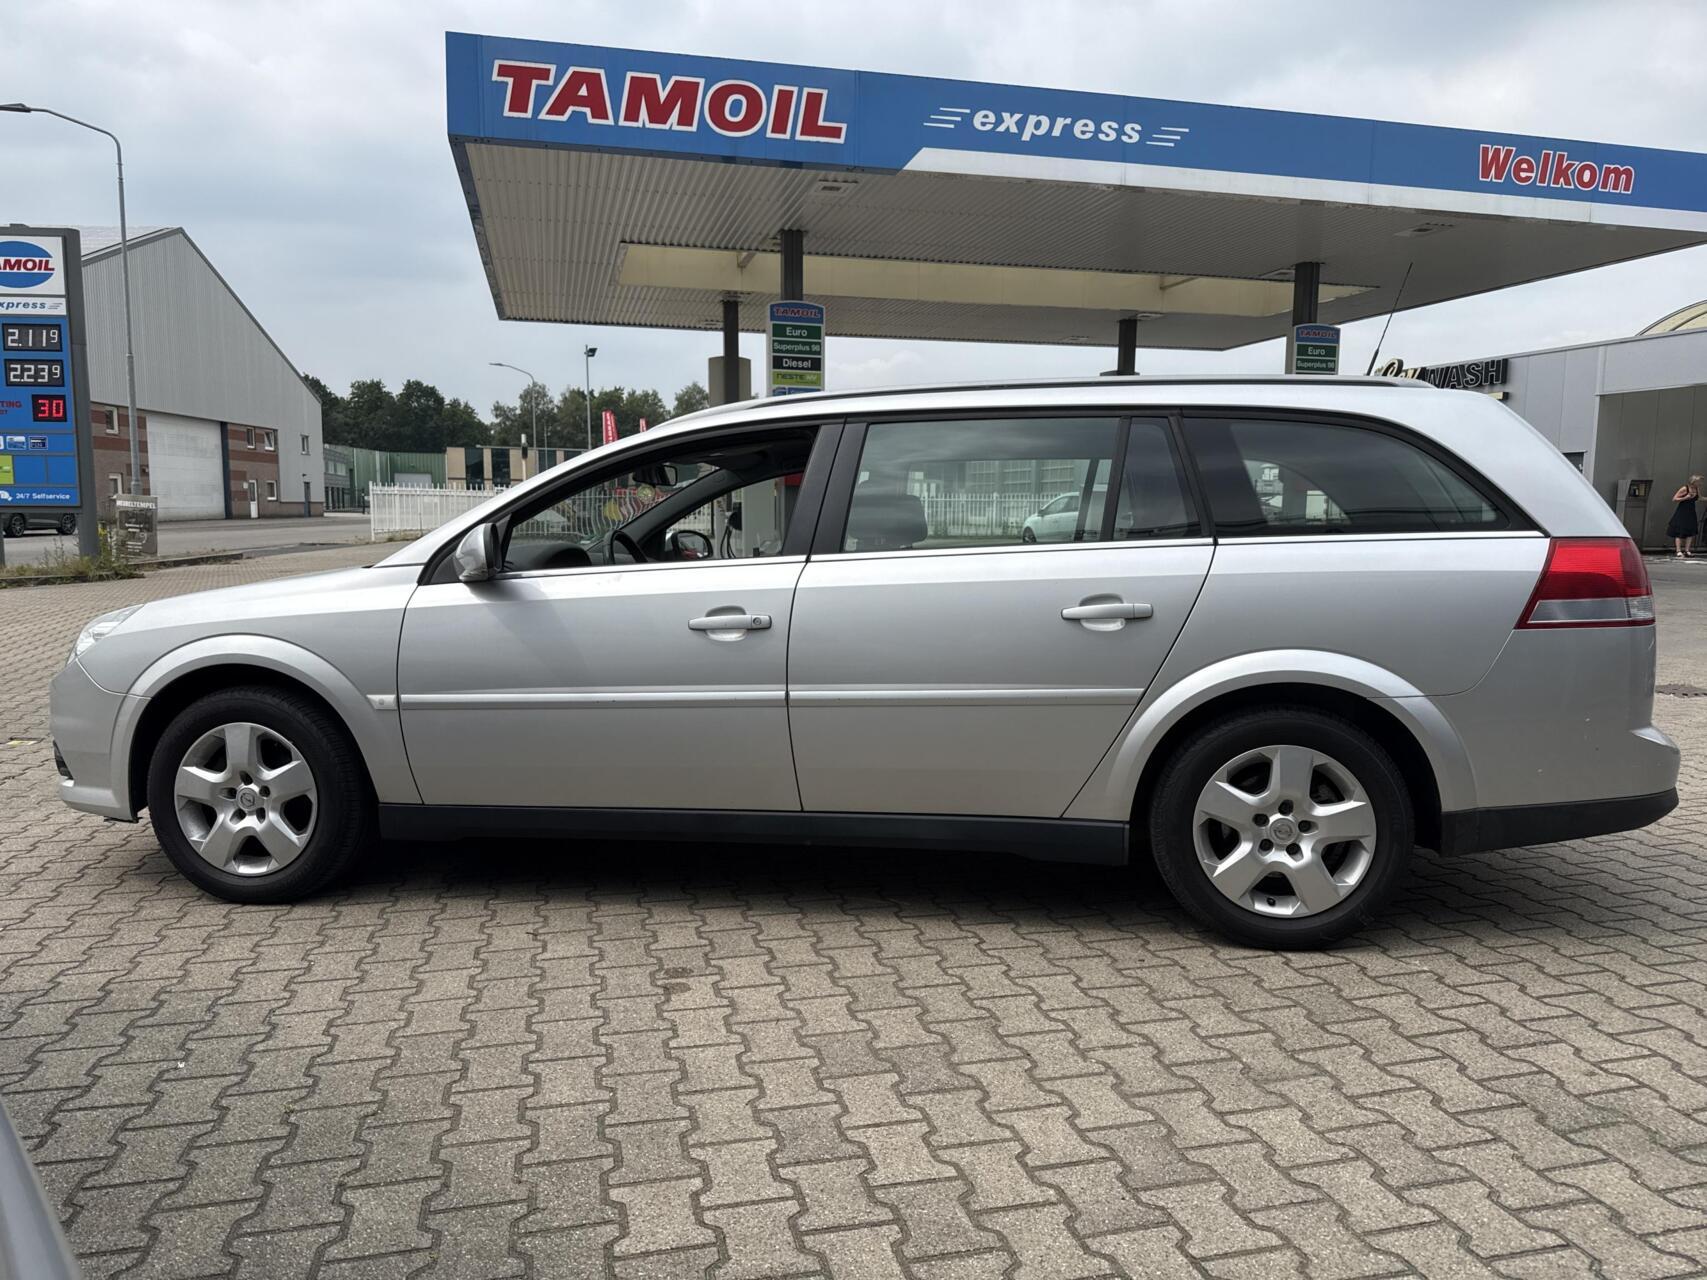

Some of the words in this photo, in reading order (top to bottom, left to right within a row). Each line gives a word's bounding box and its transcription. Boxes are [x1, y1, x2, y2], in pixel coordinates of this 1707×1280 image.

[491, 58, 848, 144] TAMOIL
[971, 106, 1142, 144] express
[1479, 144, 1635, 194] Welkom
[0, 258, 55, 272] MOIL
[774, 307, 820, 318] TAMOIL
[786, 327, 808, 337] Euro
[773, 342, 810, 352] Superplus
[1307, 346, 1326, 355] Euro
[782, 358, 812, 369] Diesel
[1426, 358, 1505, 389] WASH
[38, 399, 63, 417] 30
[32, 492, 70, 500] Selfservice
